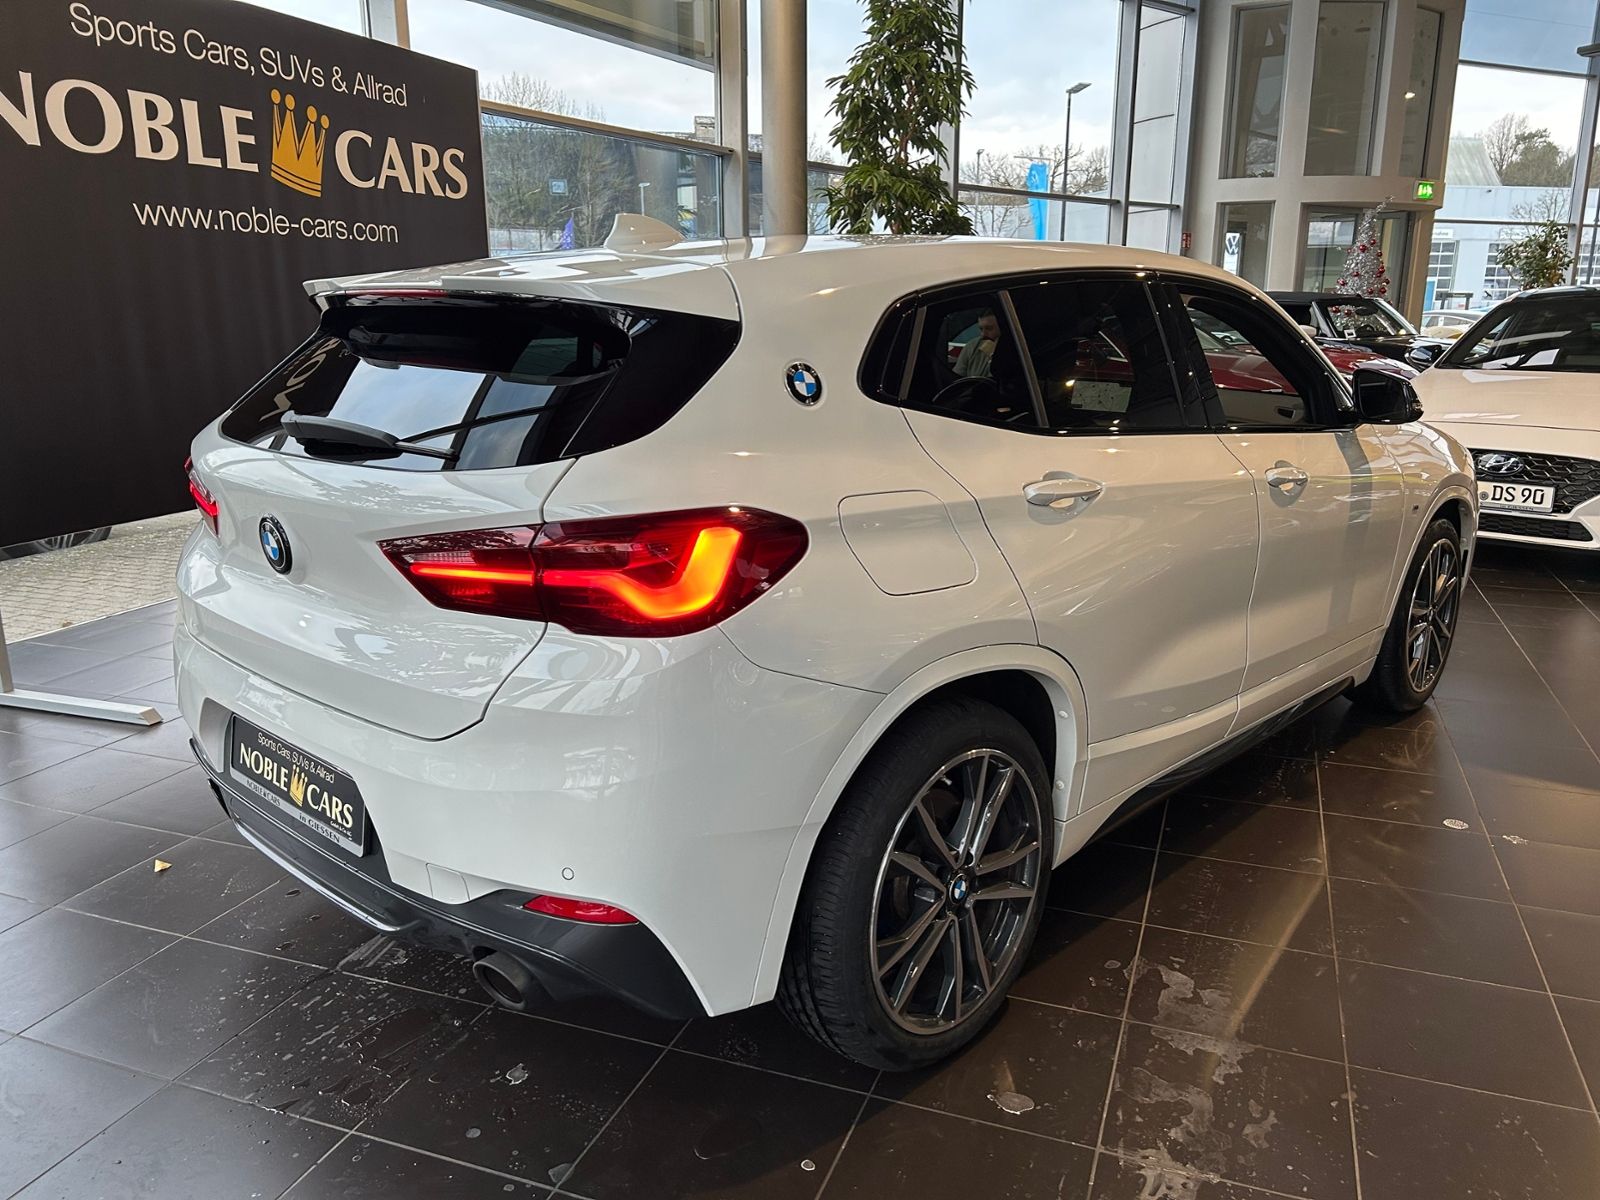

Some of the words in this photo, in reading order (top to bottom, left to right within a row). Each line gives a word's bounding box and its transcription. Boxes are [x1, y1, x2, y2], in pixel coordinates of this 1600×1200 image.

[70, 2, 176, 54] Sports
[183, 29, 255, 76] Cars,
[260, 47, 325, 87] SUVs
[332, 66, 348, 93] &
[353, 72, 408, 107] Allrad
[0, 70, 259, 173] NOBLE
[335, 130, 468, 200] CARS
[133, 202, 399, 243] www.noble-cars.com
[1491, 485, 1516, 502] DS
[1521, 488, 1544, 505] 90
[258, 732, 276, 751] Sports
[315, 765, 335, 784] Allrad
[240, 743, 289, 792] NOBLE
[307, 784, 353, 829] CARS
[308, 819, 340, 843] GIESSEN
